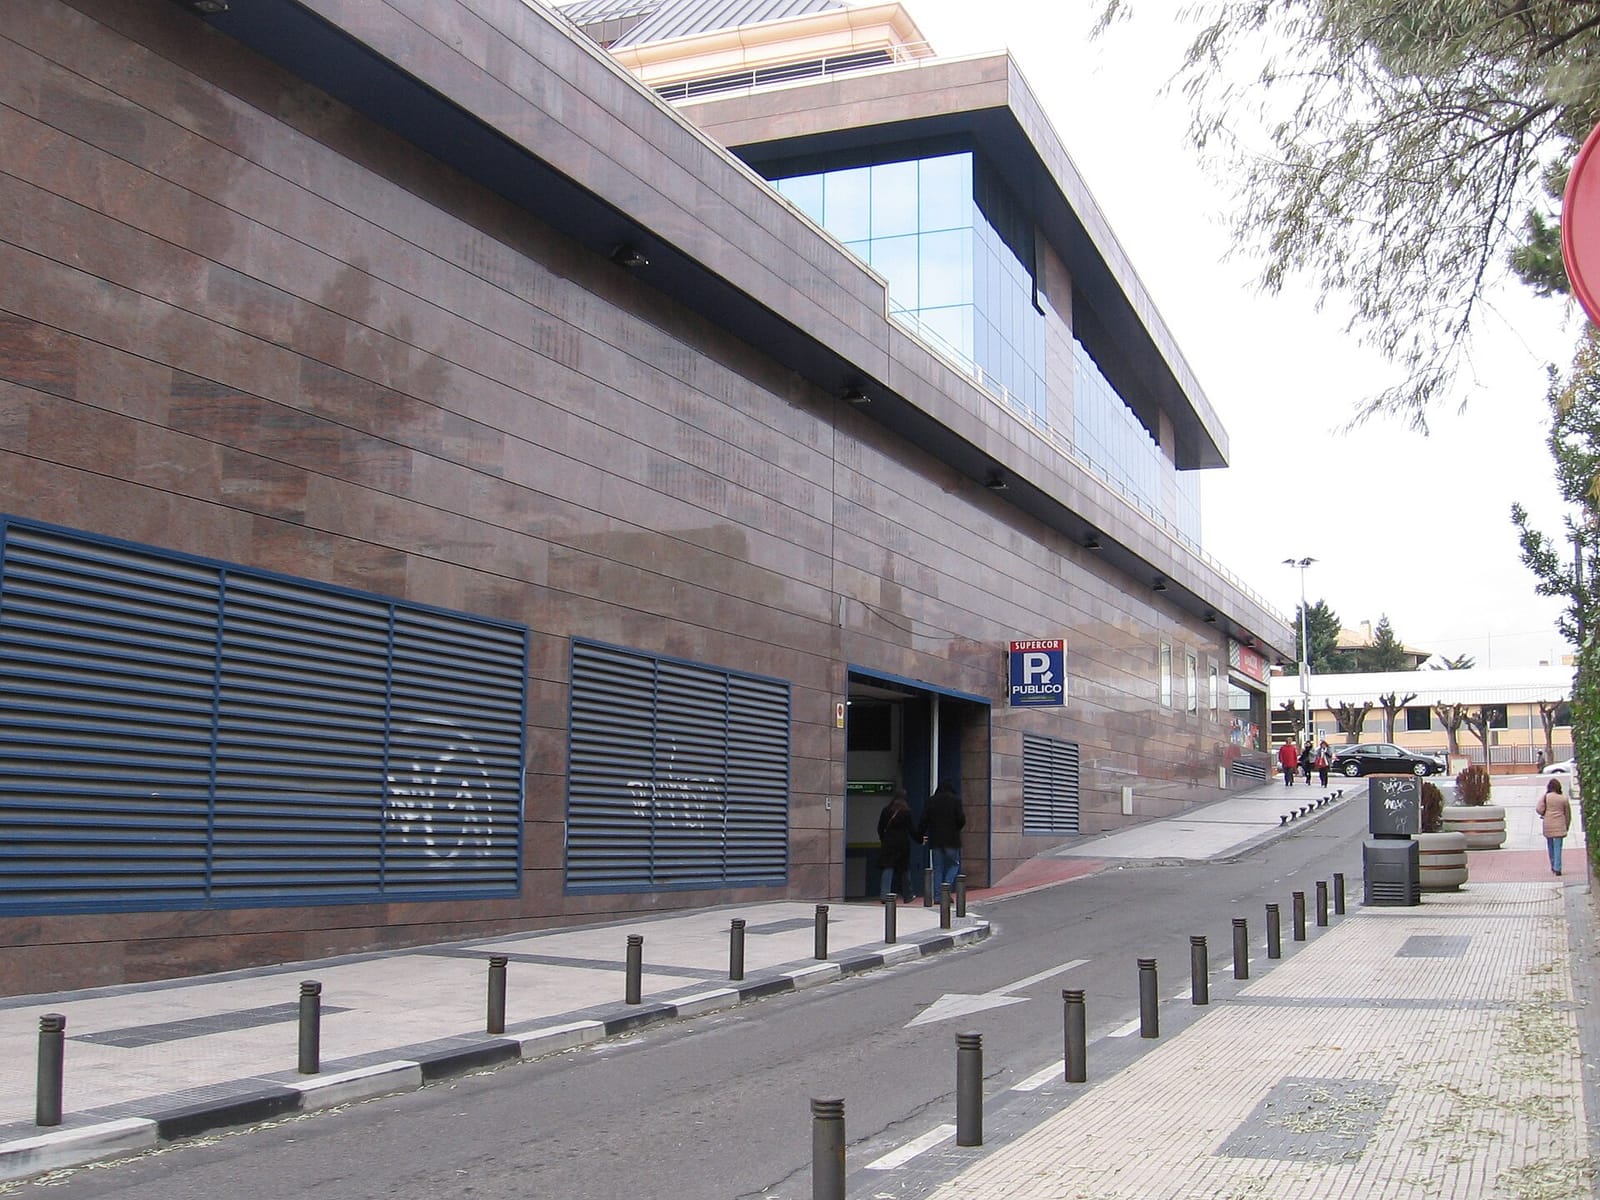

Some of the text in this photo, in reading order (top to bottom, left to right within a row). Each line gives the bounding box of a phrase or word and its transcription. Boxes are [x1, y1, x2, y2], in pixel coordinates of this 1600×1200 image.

[1015, 640, 1058, 650] SUPERCOR
[1023, 652, 1050, 684] P
[1012, 684, 1062, 694] PUBLICO
